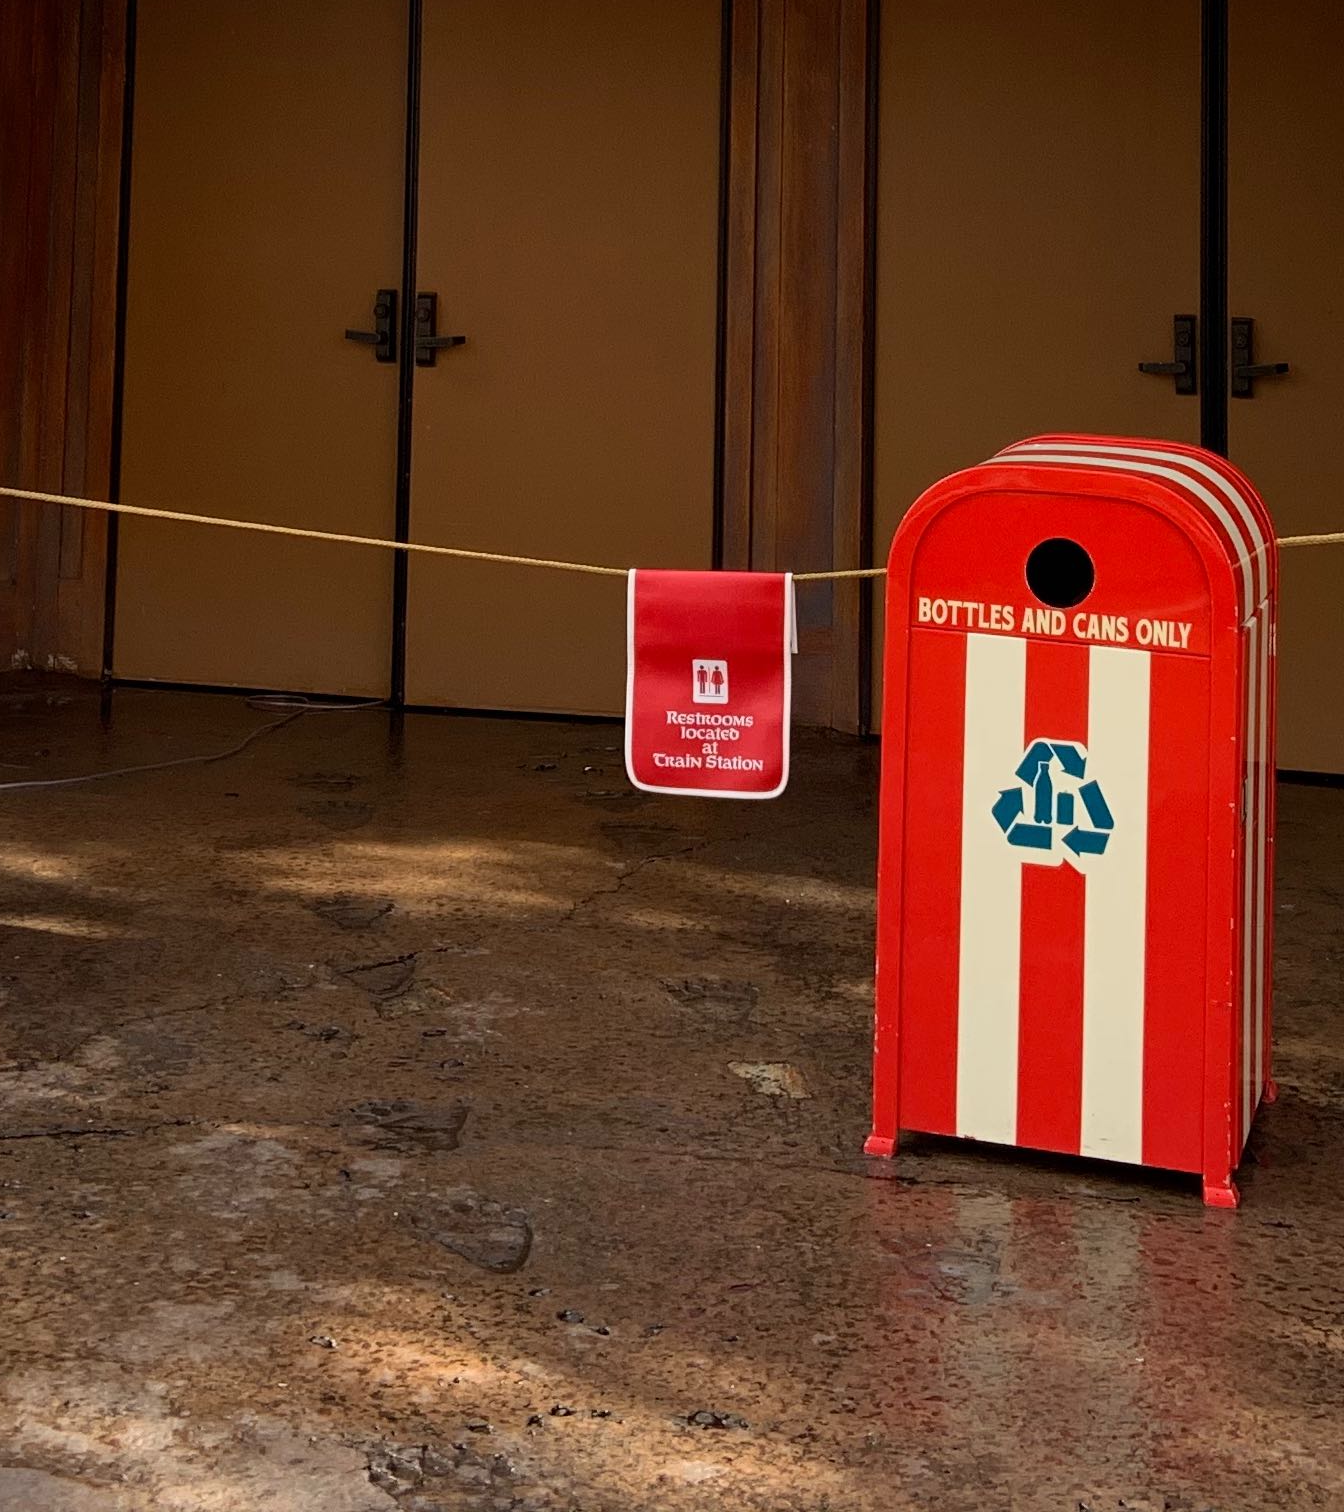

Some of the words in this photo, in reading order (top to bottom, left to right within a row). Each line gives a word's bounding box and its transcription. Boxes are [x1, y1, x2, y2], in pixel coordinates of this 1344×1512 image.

[917, 597, 1015, 631] BOTTLES
[1021, 609, 1066, 636] AND
[1073, 613, 1129, 643] CANS
[1136, 620, 1192, 649] ONLY
[702, 742, 718, 755] at
